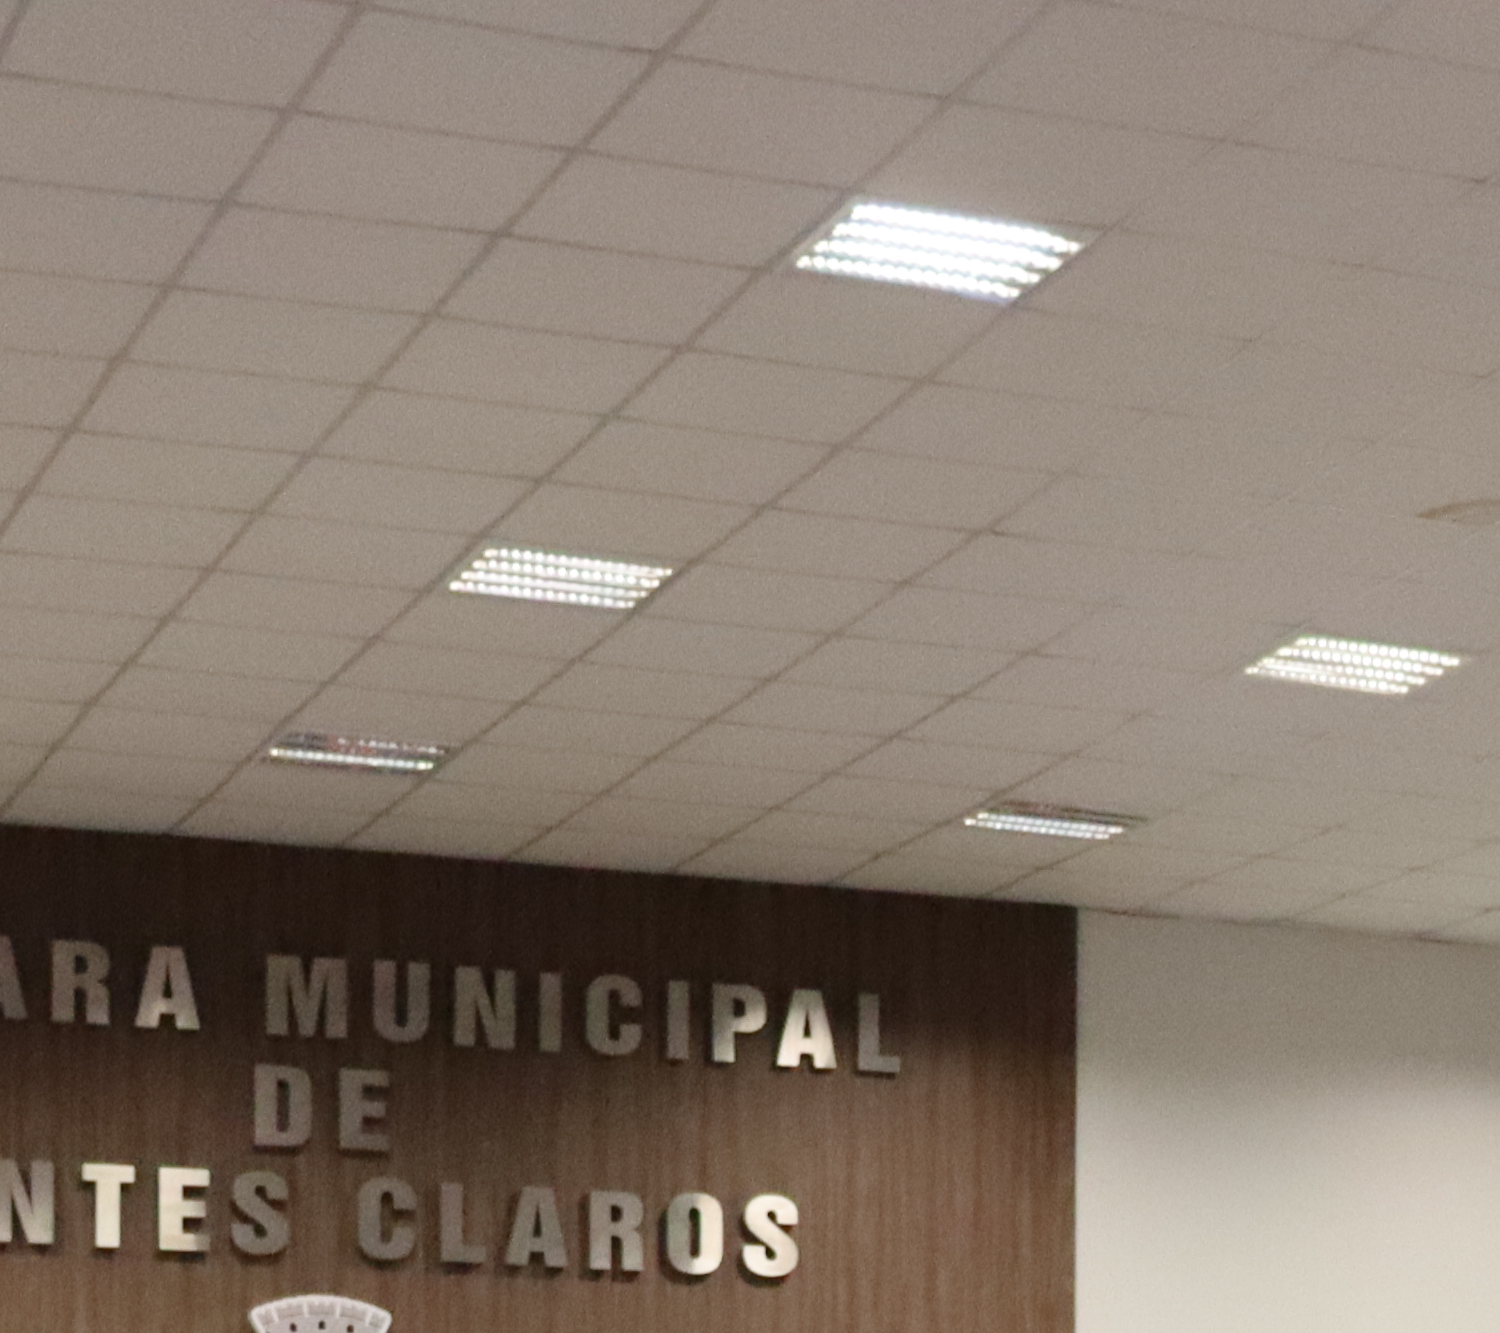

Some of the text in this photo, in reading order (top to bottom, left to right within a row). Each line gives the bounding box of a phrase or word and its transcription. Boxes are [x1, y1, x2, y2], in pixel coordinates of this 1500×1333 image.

[264, 953, 902, 1075] MUNICIPAL
[252, 1064, 390, 1155] DE
[356, 1178, 801, 1279] CLAROS
